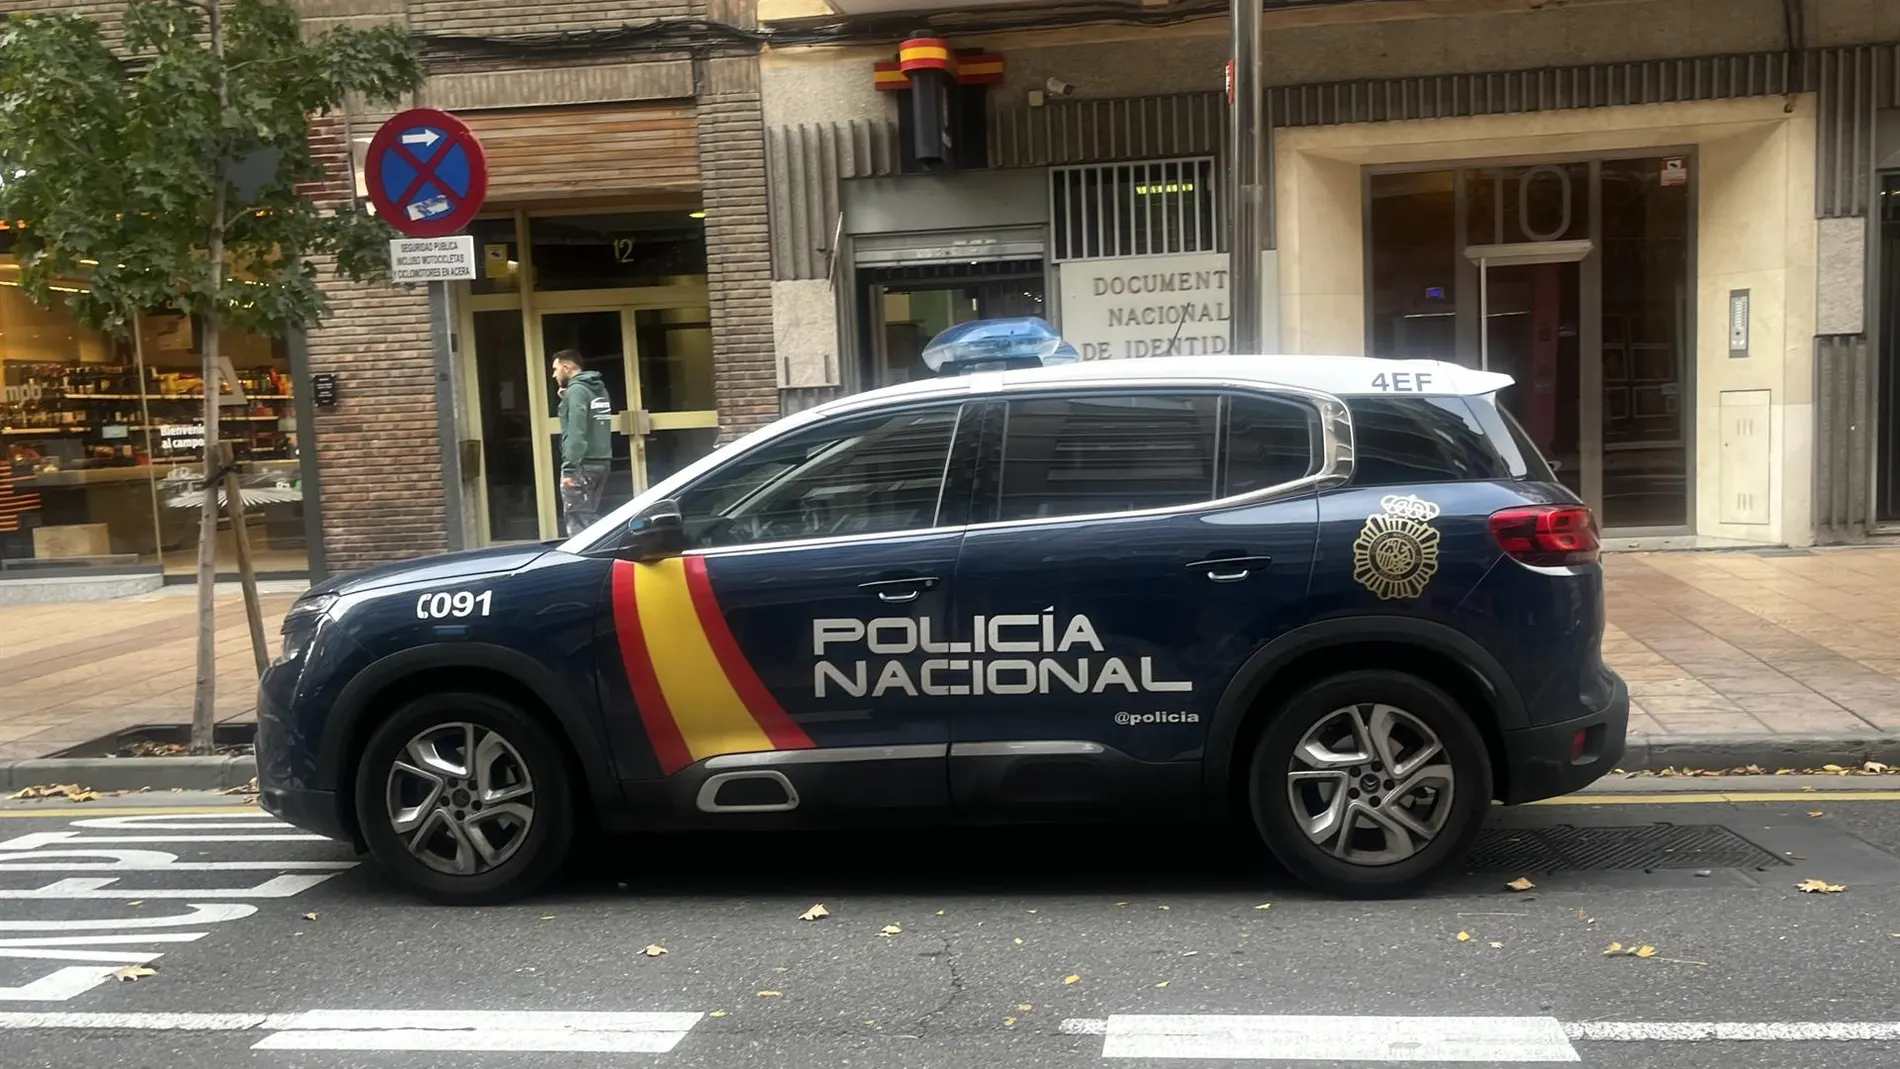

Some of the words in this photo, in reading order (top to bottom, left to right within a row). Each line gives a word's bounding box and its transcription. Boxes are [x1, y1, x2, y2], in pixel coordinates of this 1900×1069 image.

[422, 254, 464, 265] MOTOCICLETAS
[613, 238, 635, 264] 12
[398, 268, 440, 279] CICLOMOTORES
[441, 267, 450, 277] EN
[451, 266, 470, 277] ACERA
[1093, 270, 1228, 296] DOCUMENT
[1108, 303, 1231, 327] NACIONAL
[1081, 341, 1112, 361] DE
[1125, 335, 1231, 360] IDENTID
[1371, 372, 1432, 392] 4EF
[160, 423, 205, 437] Bienveni
[161, 438, 172, 448] al
[430, 590, 492, 618] 091
[813, 605, 1104, 656] POLICÍA
[814, 656, 1193, 698] NACIONAL
[1114, 711, 1200, 726] @policia
